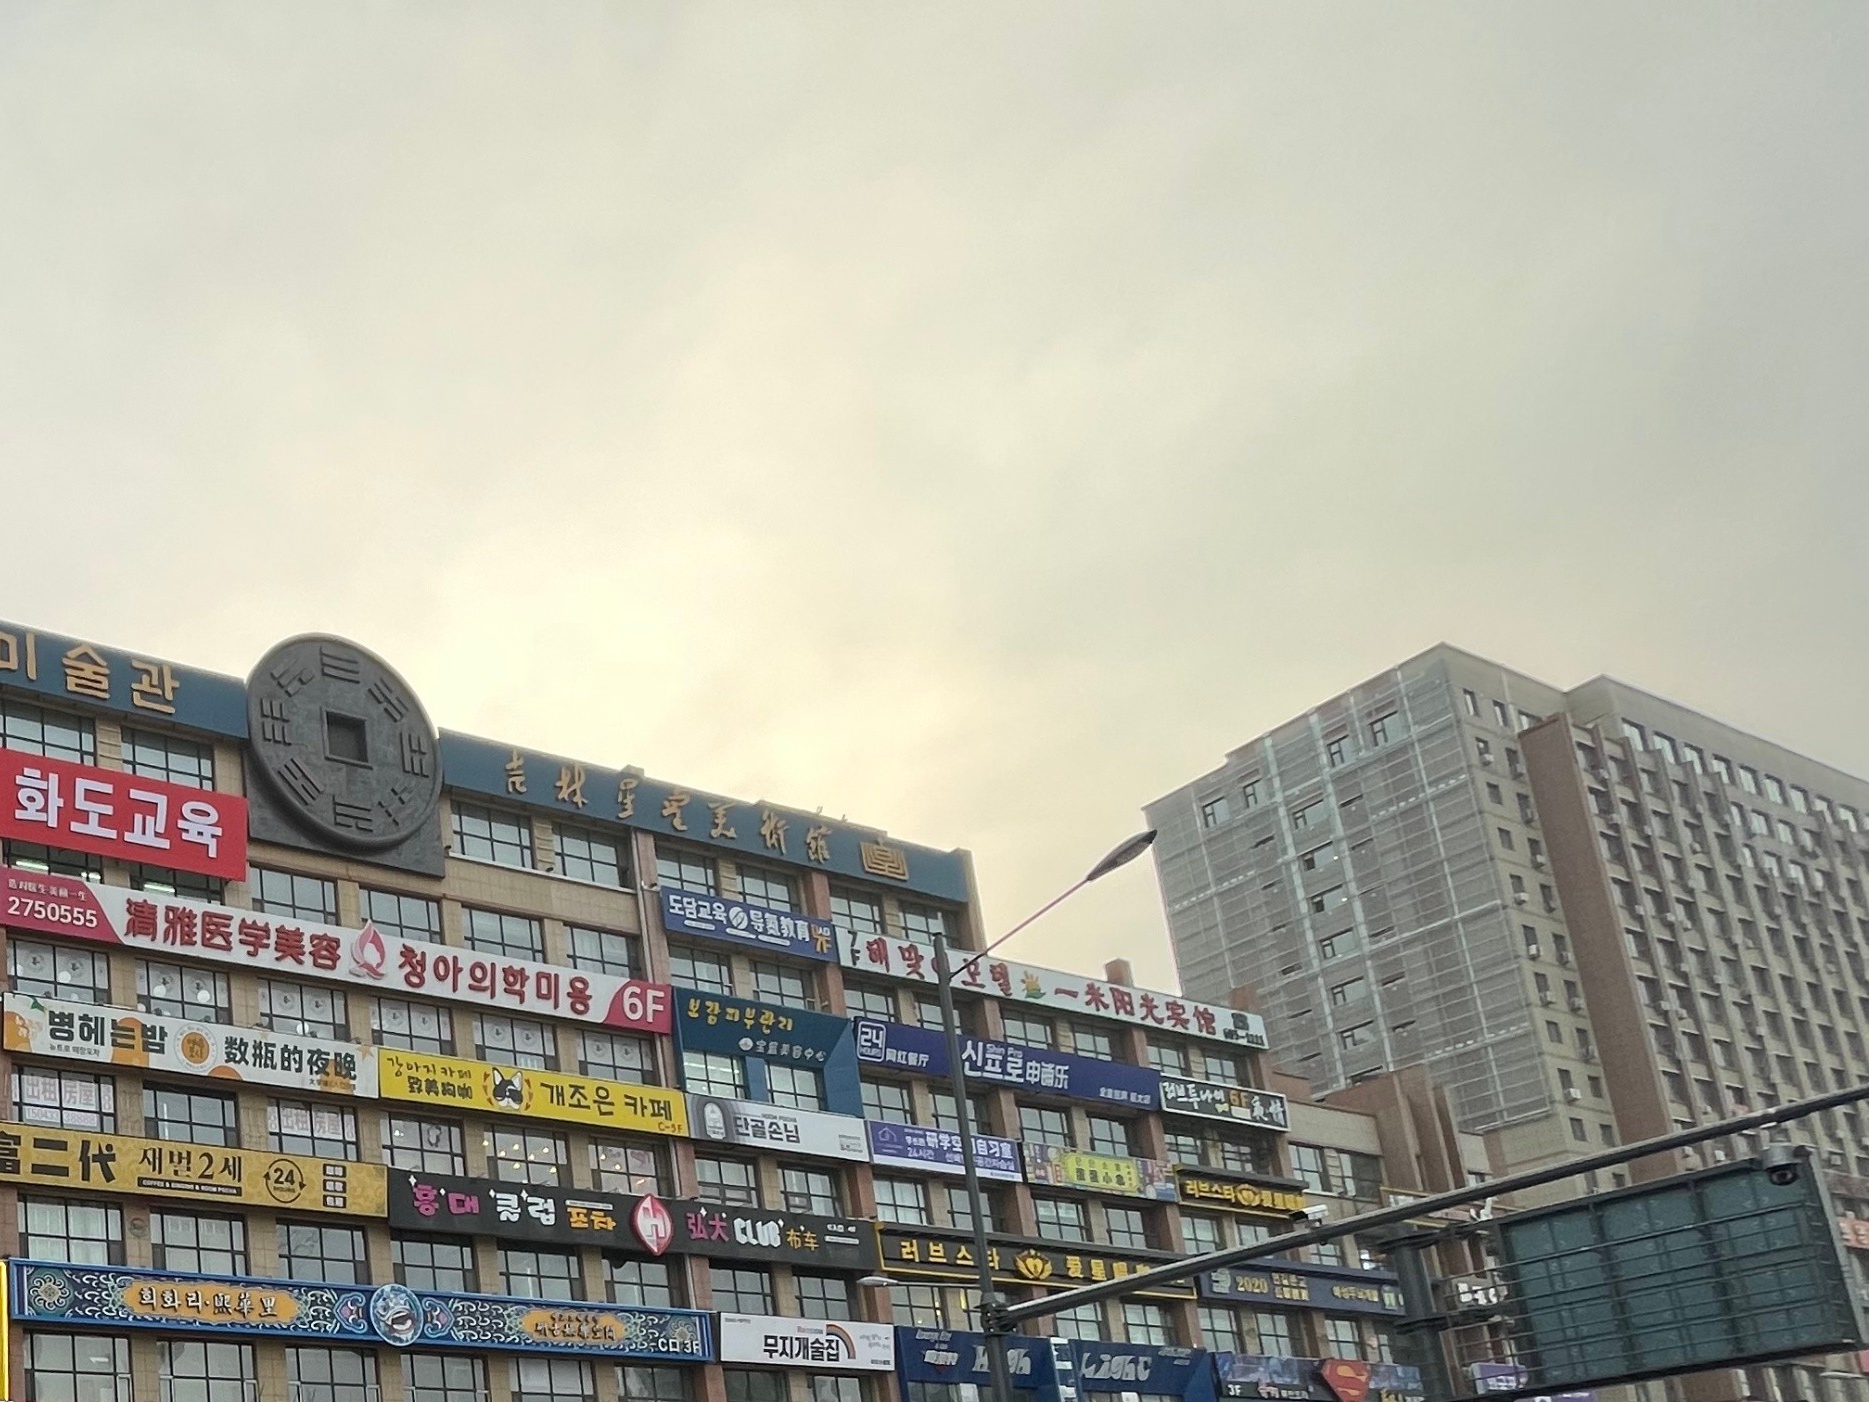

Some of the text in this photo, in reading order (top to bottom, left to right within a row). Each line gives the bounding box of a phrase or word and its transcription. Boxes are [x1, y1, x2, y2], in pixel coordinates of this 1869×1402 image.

[15, 766, 223, 859] 화도교육
[7, 895, 99, 929] 2750555
[668, 893, 728, 925] 도담교육
[124, 897, 342, 970] 清雅医学美容
[398, 943, 593, 1017] 청아의학미용
[621, 984, 666, 1023] 6F
[860, 1027, 884, 1049] 24
[224, 1035, 358, 1080] 数瓶的夜晚
[386, 1055, 437, 1078] 강아지
[540, 1081, 674, 1122] 개조은 카페
[732, 1115, 801, 1144] 단골손님
[925, 1130, 1014, 1160] 研学空自习室
[138, 1146, 242, 1184] 재벌2세
[273, 1167, 295, 1186] 24
[412, 1184, 480, 1217] 홍대
[1235, 1275, 1269, 1294] 2020
[762, 1334, 841, 1363] 무지개술집
